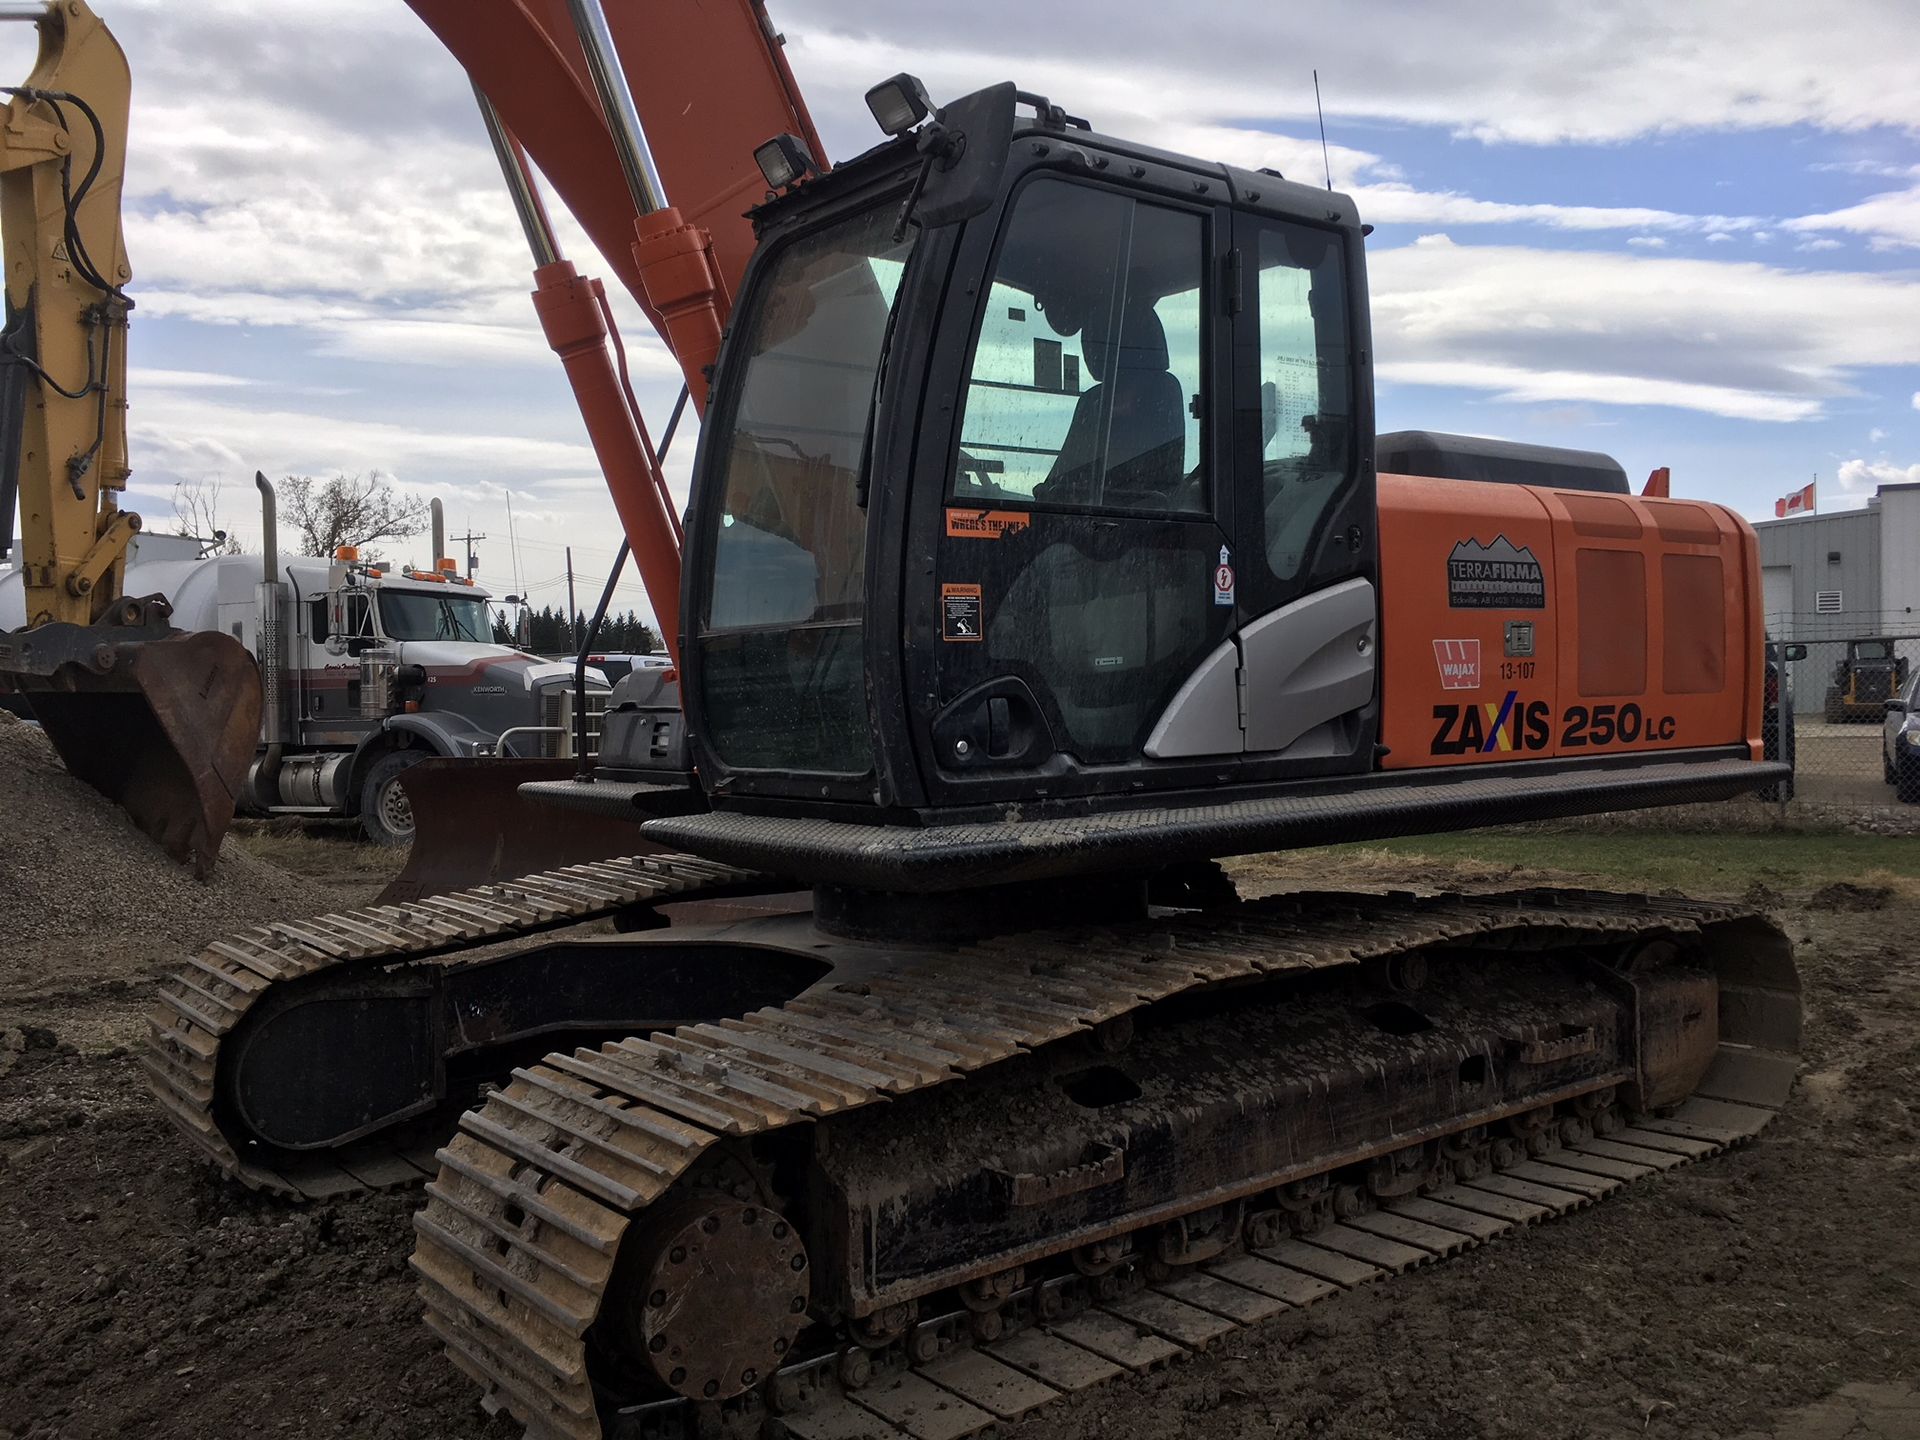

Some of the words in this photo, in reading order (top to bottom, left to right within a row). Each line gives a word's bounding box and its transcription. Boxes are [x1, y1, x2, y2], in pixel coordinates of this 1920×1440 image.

[988, 520, 1003, 532] THE
[1443, 663, 1475, 679] WAJAX
[1500, 662, 1535, 680] 13-107
[1430, 690, 1550, 755] ZAXIS
